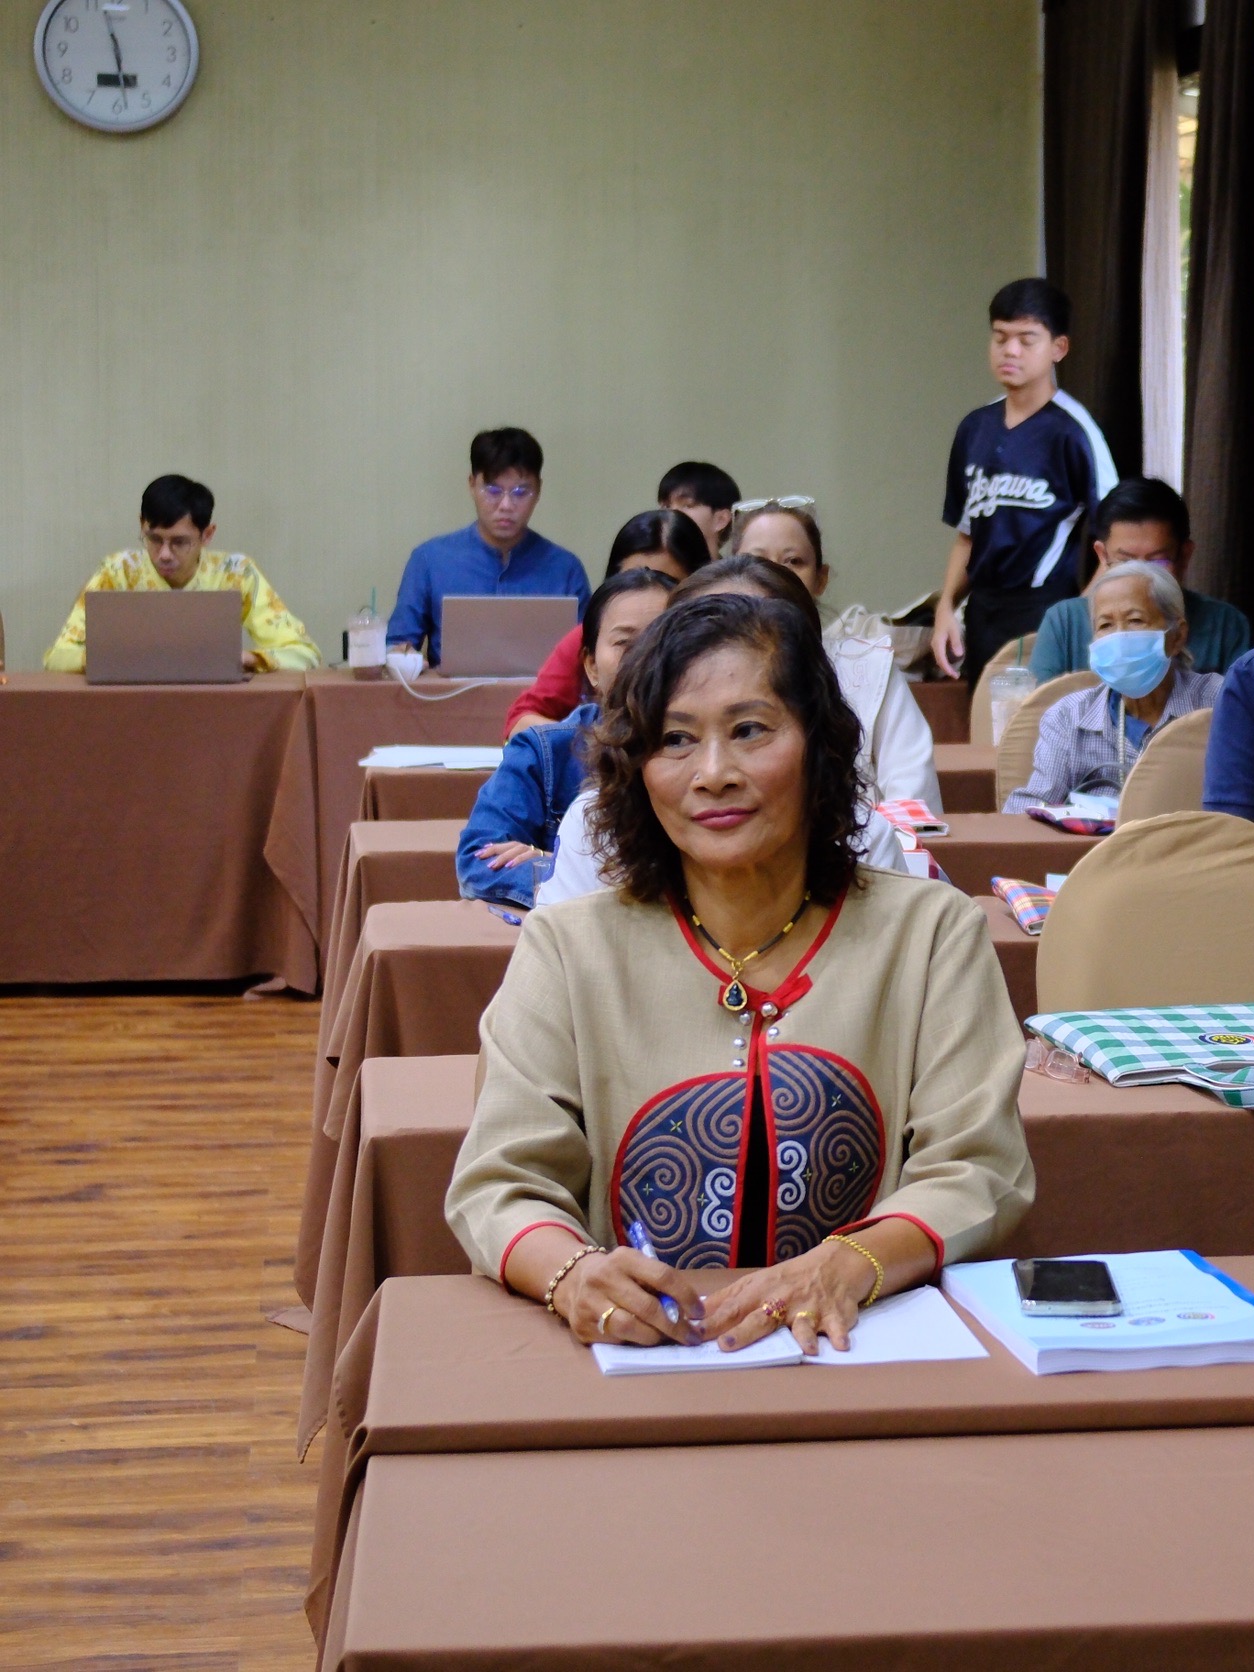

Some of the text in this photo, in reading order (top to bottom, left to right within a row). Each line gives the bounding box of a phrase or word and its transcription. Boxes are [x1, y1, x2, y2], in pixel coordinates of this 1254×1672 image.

[64, 16, 79, 34] 10
[162, 21, 173, 36] 2
[57, 41, 68, 58] 9
[166, 47, 177, 63] 3
[61, 68, 72, 84] 8
[161, 75, 171, 88] 4
[112, 99, 123, 114] 6
